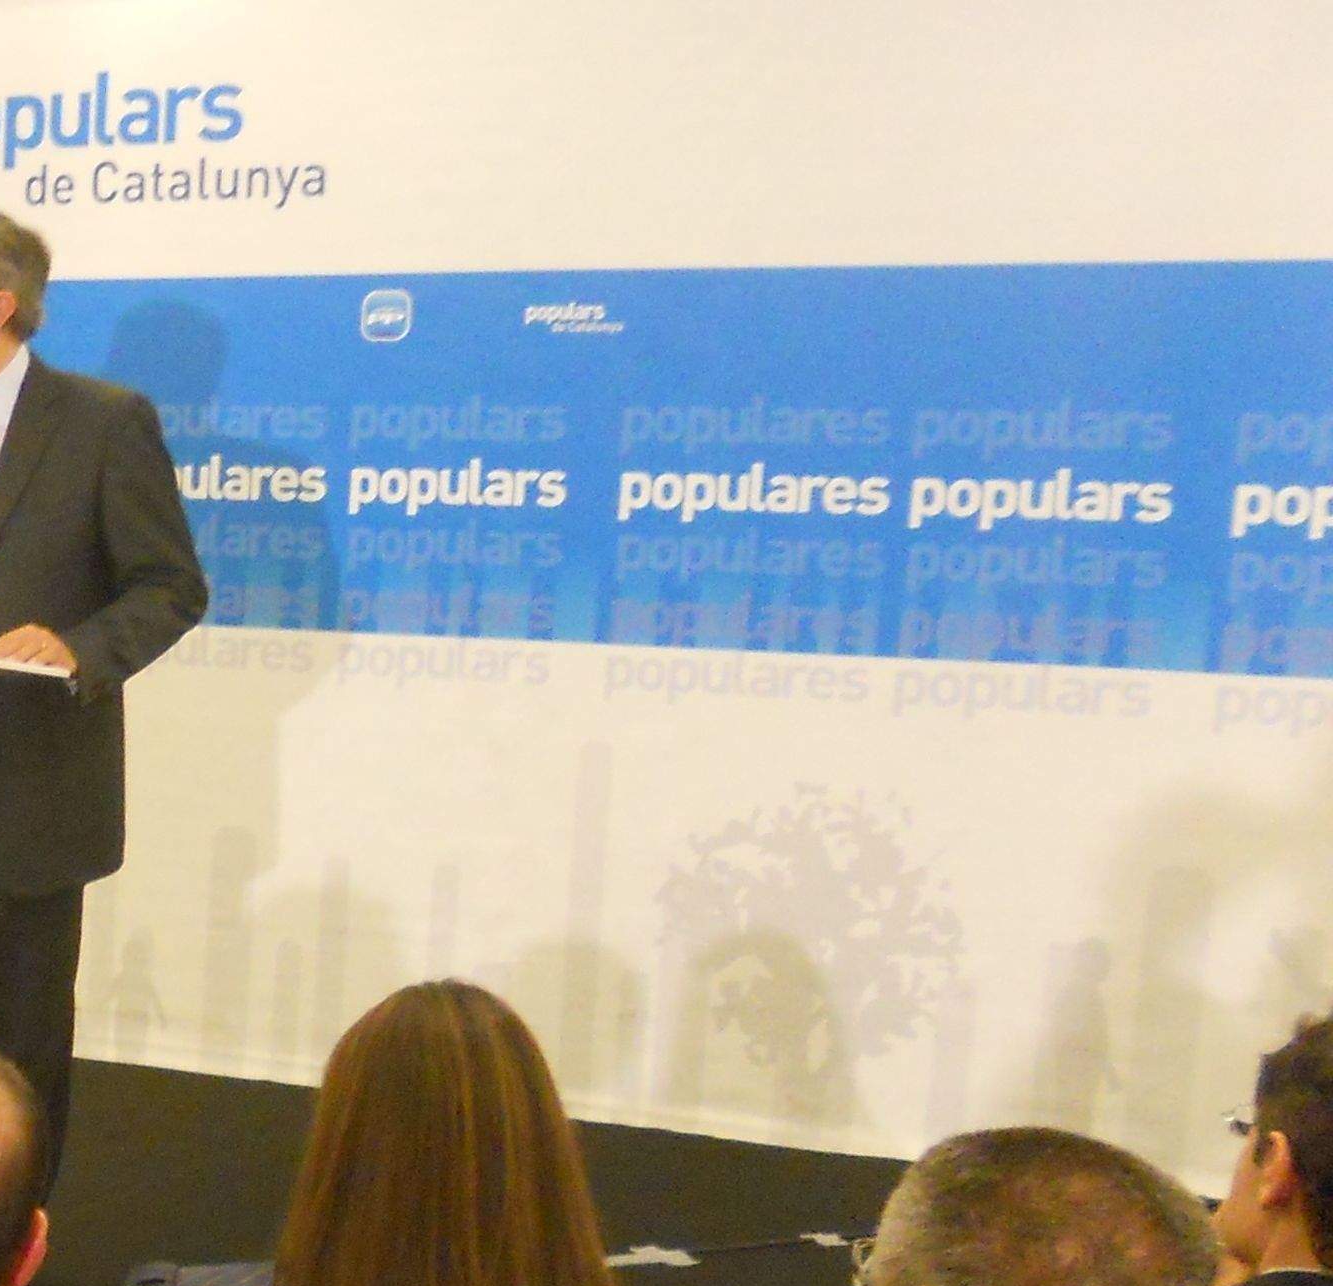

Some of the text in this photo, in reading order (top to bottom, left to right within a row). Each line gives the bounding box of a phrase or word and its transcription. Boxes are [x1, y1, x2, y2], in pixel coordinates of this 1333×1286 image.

[25, 157, 327, 209] de Catalunya
[523, 302, 606, 325] populars
[348, 396, 568, 451] populars
[620, 396, 891, 456] populares
[910, 399, 1176, 459] populars
[179, 452, 329, 502] ulares
[348, 457, 569, 516] populars
[617, 462, 892, 524] populares
[906, 467, 1174, 531] populars
